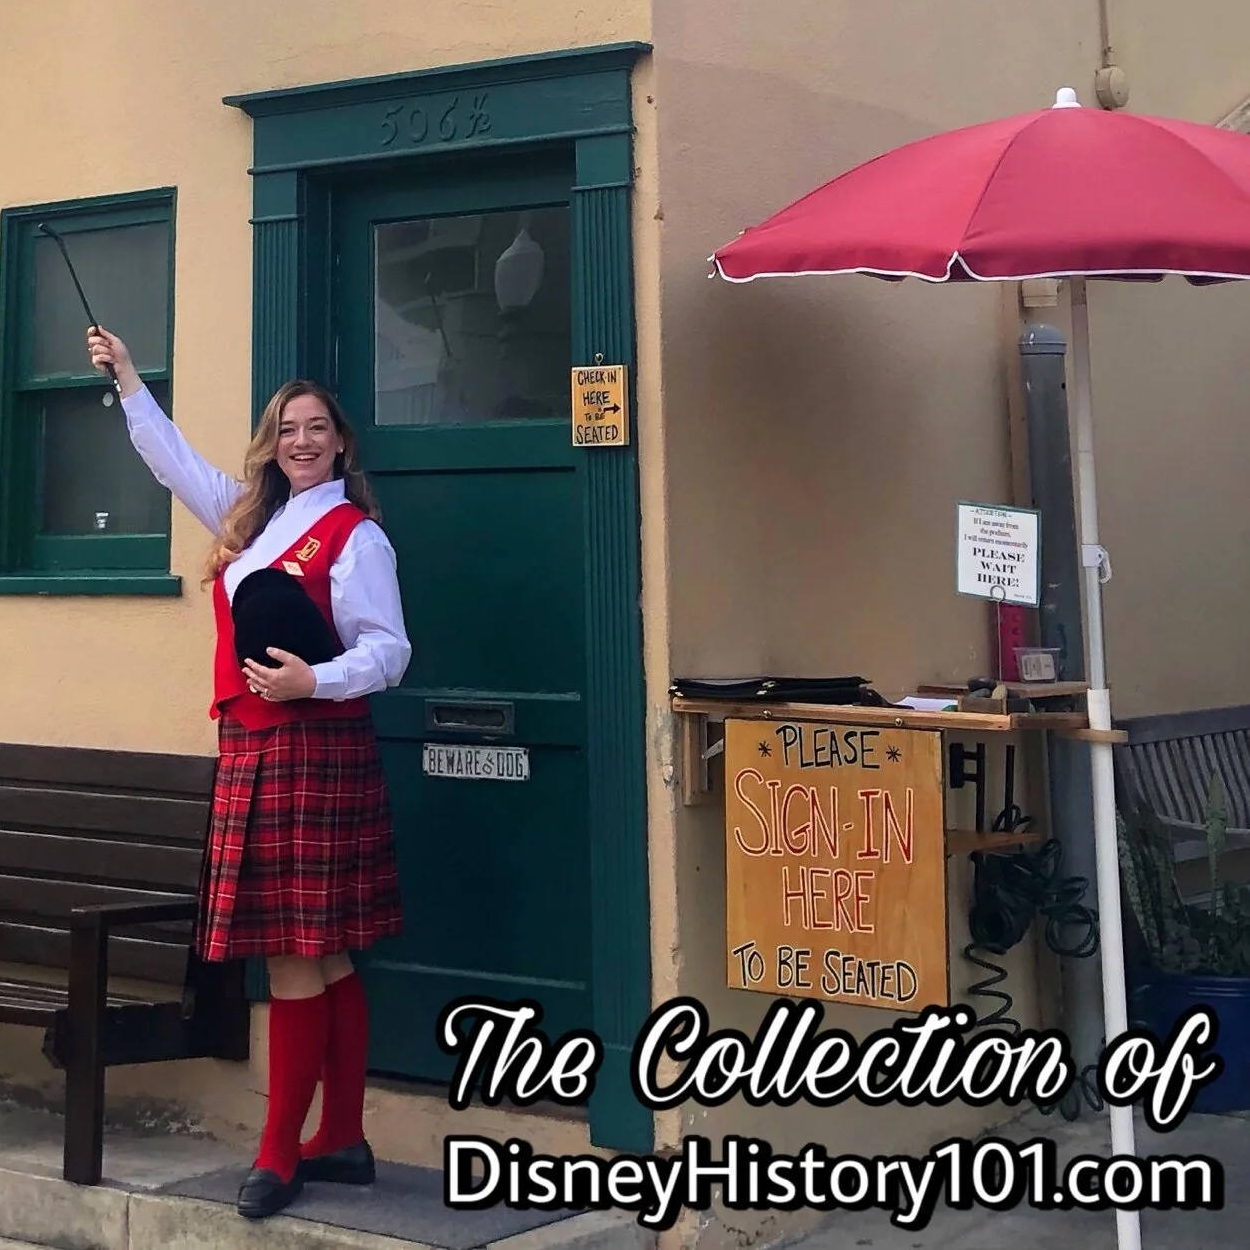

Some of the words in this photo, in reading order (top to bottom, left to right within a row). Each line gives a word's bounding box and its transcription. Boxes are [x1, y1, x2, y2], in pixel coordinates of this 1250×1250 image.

[583, 390, 610, 406] HERE
[576, 424, 619, 444] SEATED
[972, 547, 1025, 563] PLEASE
[980, 560, 1017, 574] WAIT
[977, 573, 1020, 588] HERE!
[775, 724, 881, 770] PLEASE
[428, 749, 482, 775] BEWARE
[497, 752, 524, 777] DOG
[782, 866, 875, 933] HERE
[776, 945, 813, 990] BE
[820, 949, 918, 1003] SEATED
